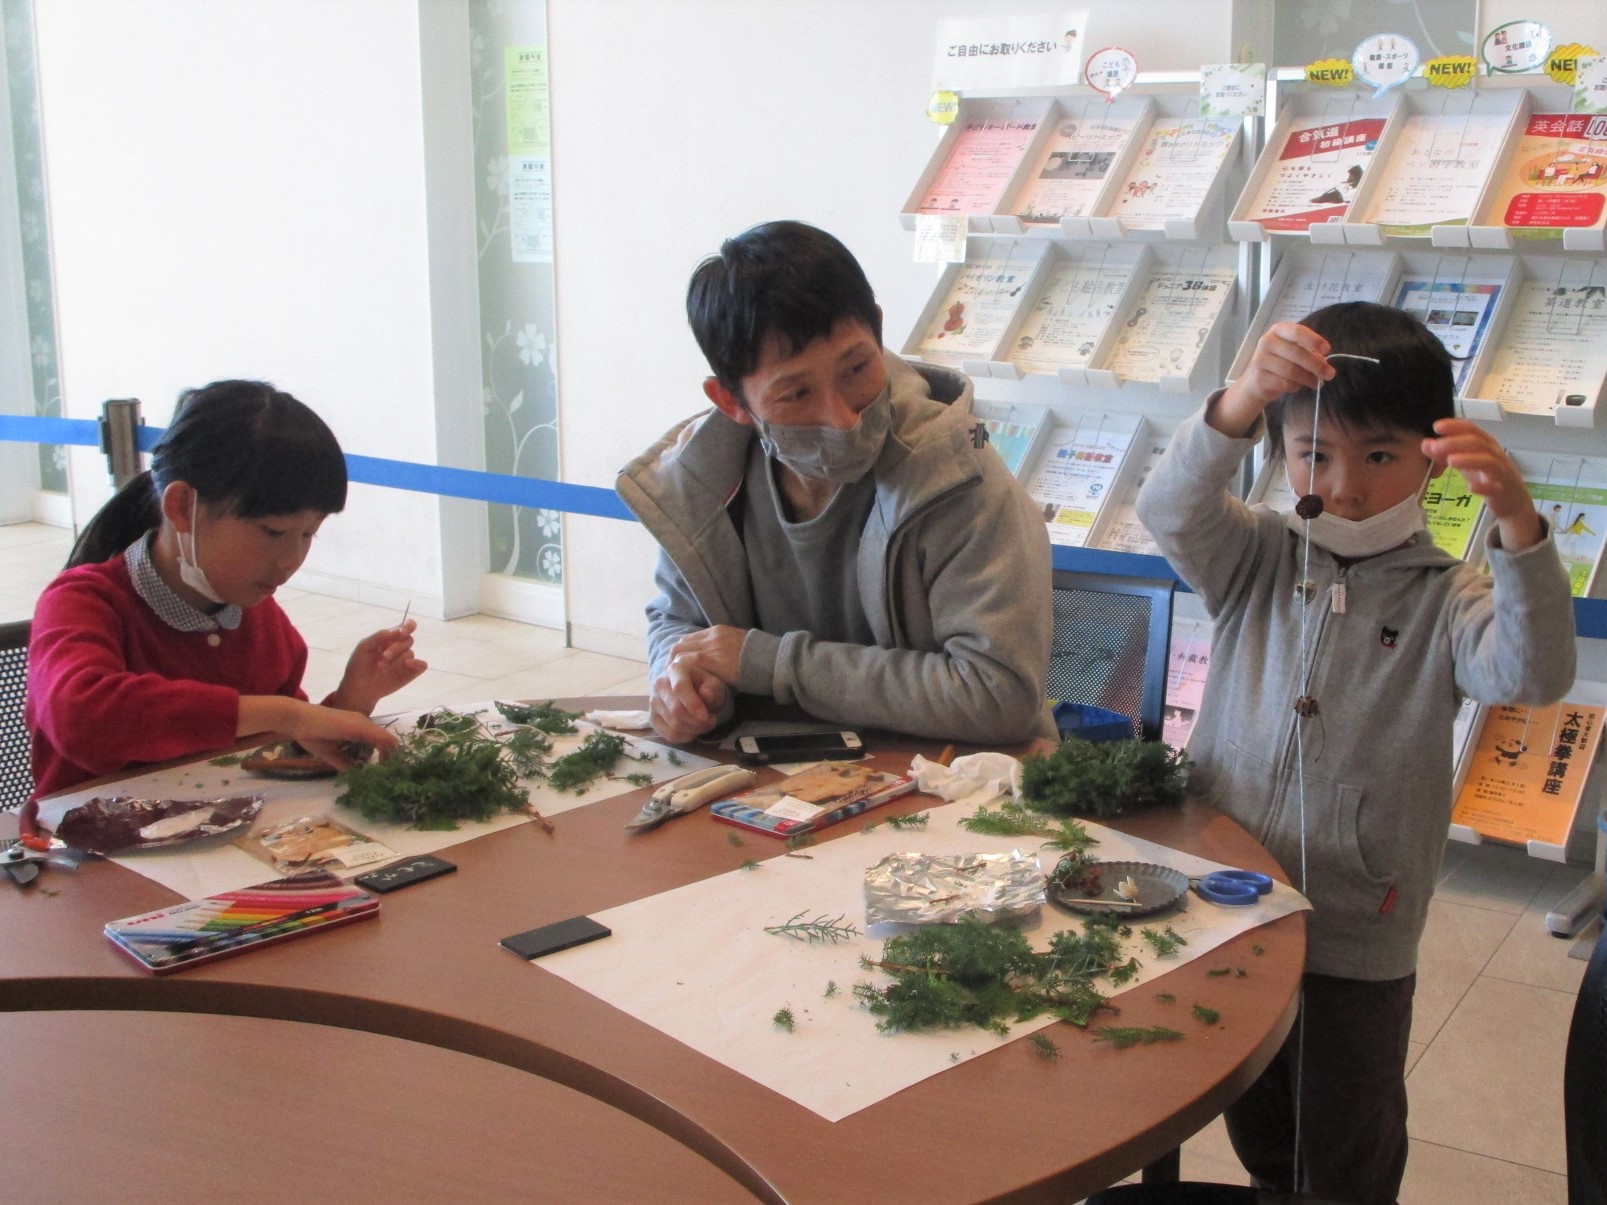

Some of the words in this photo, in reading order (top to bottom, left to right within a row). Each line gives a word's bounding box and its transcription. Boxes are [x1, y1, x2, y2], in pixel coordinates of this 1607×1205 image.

[947, 41, 1057, 57] ご自由にお取りください
[1430, 62, 1471, 75] NEW!
[1550, 58, 1578, 71] NE
[1310, 68, 1349, 81] NEW!
[1531, 119, 1585, 133] 英会話
[1298, 126, 1340, 143] 合気道
[1319, 133, 1367, 149] 初級講座
